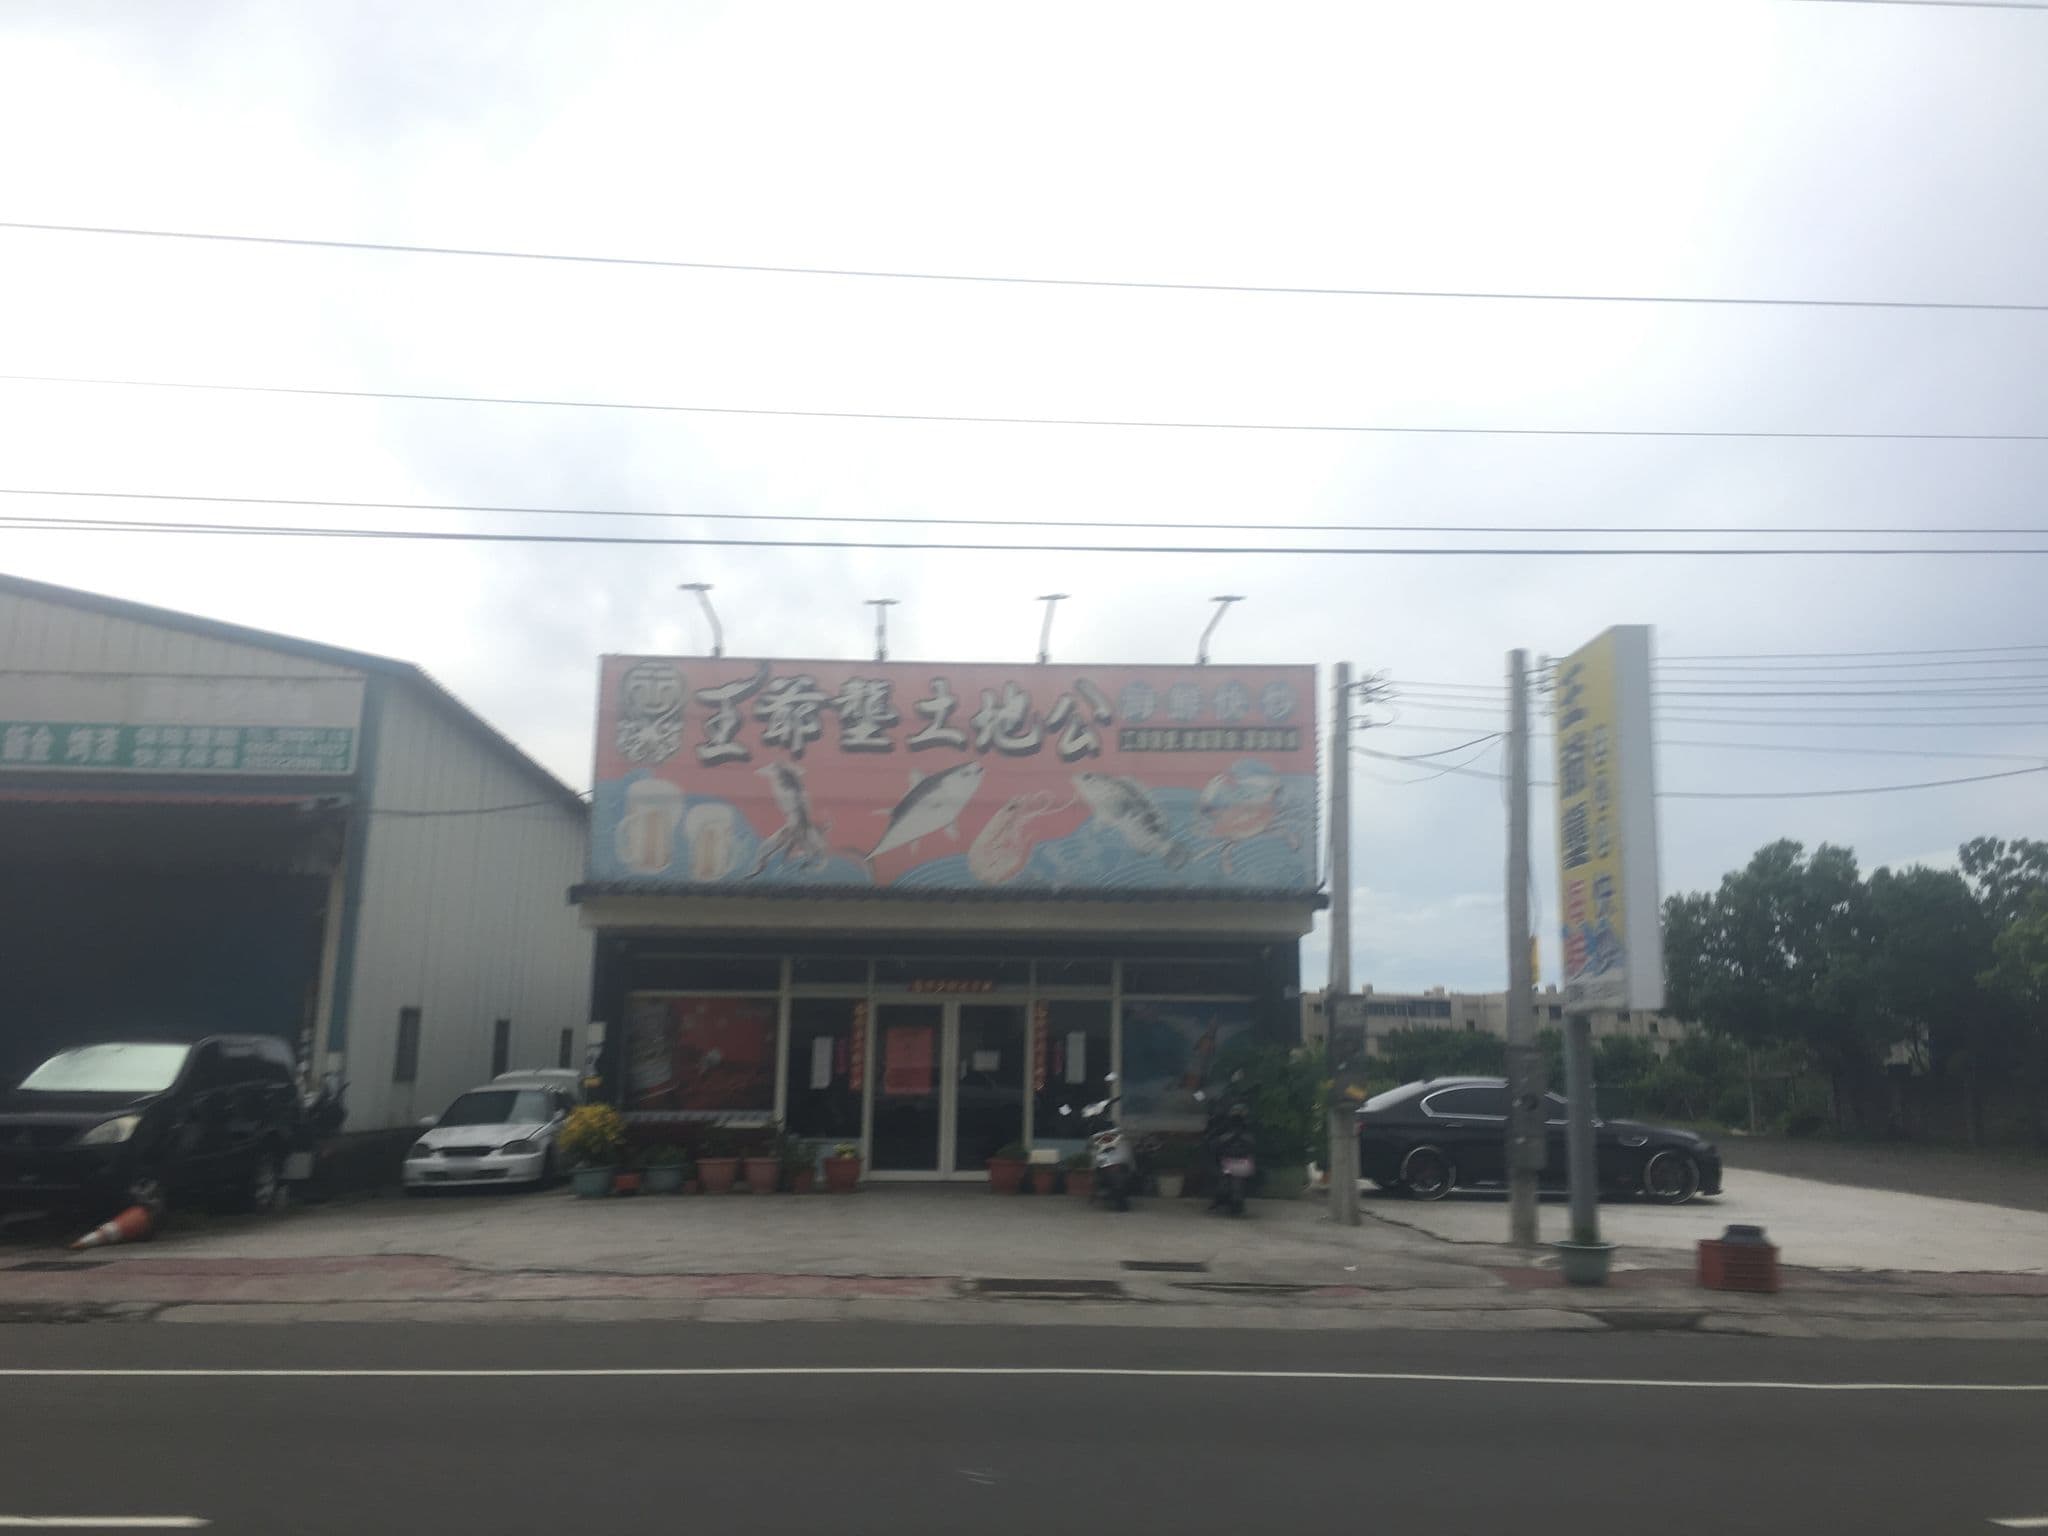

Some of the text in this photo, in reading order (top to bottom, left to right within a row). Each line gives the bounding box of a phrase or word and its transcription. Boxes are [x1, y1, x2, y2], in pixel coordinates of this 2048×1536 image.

[697, 671, 1113, 762] 王爺壟土地公
